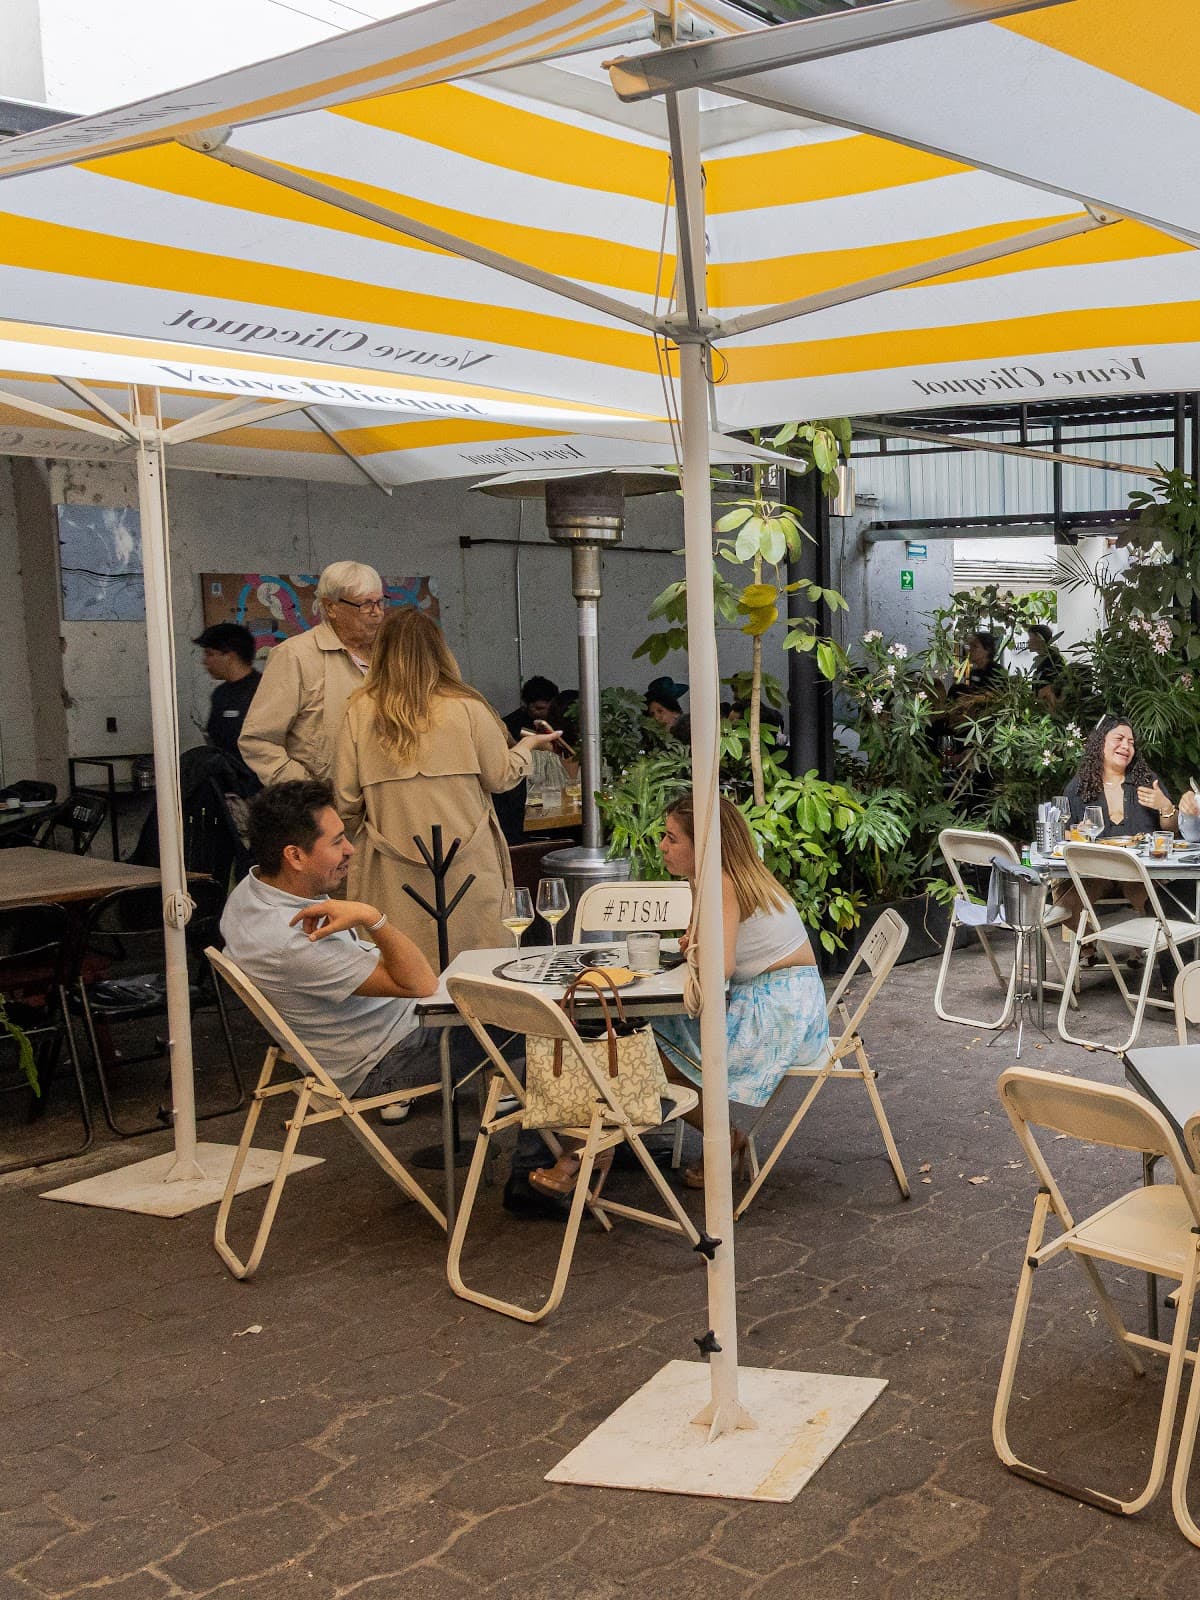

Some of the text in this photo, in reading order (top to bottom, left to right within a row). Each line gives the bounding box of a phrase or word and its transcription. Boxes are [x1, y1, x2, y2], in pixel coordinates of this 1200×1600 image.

[153, 365, 489, 416] Veuve Clicquot
[603, 900, 670, 923] #FISM
